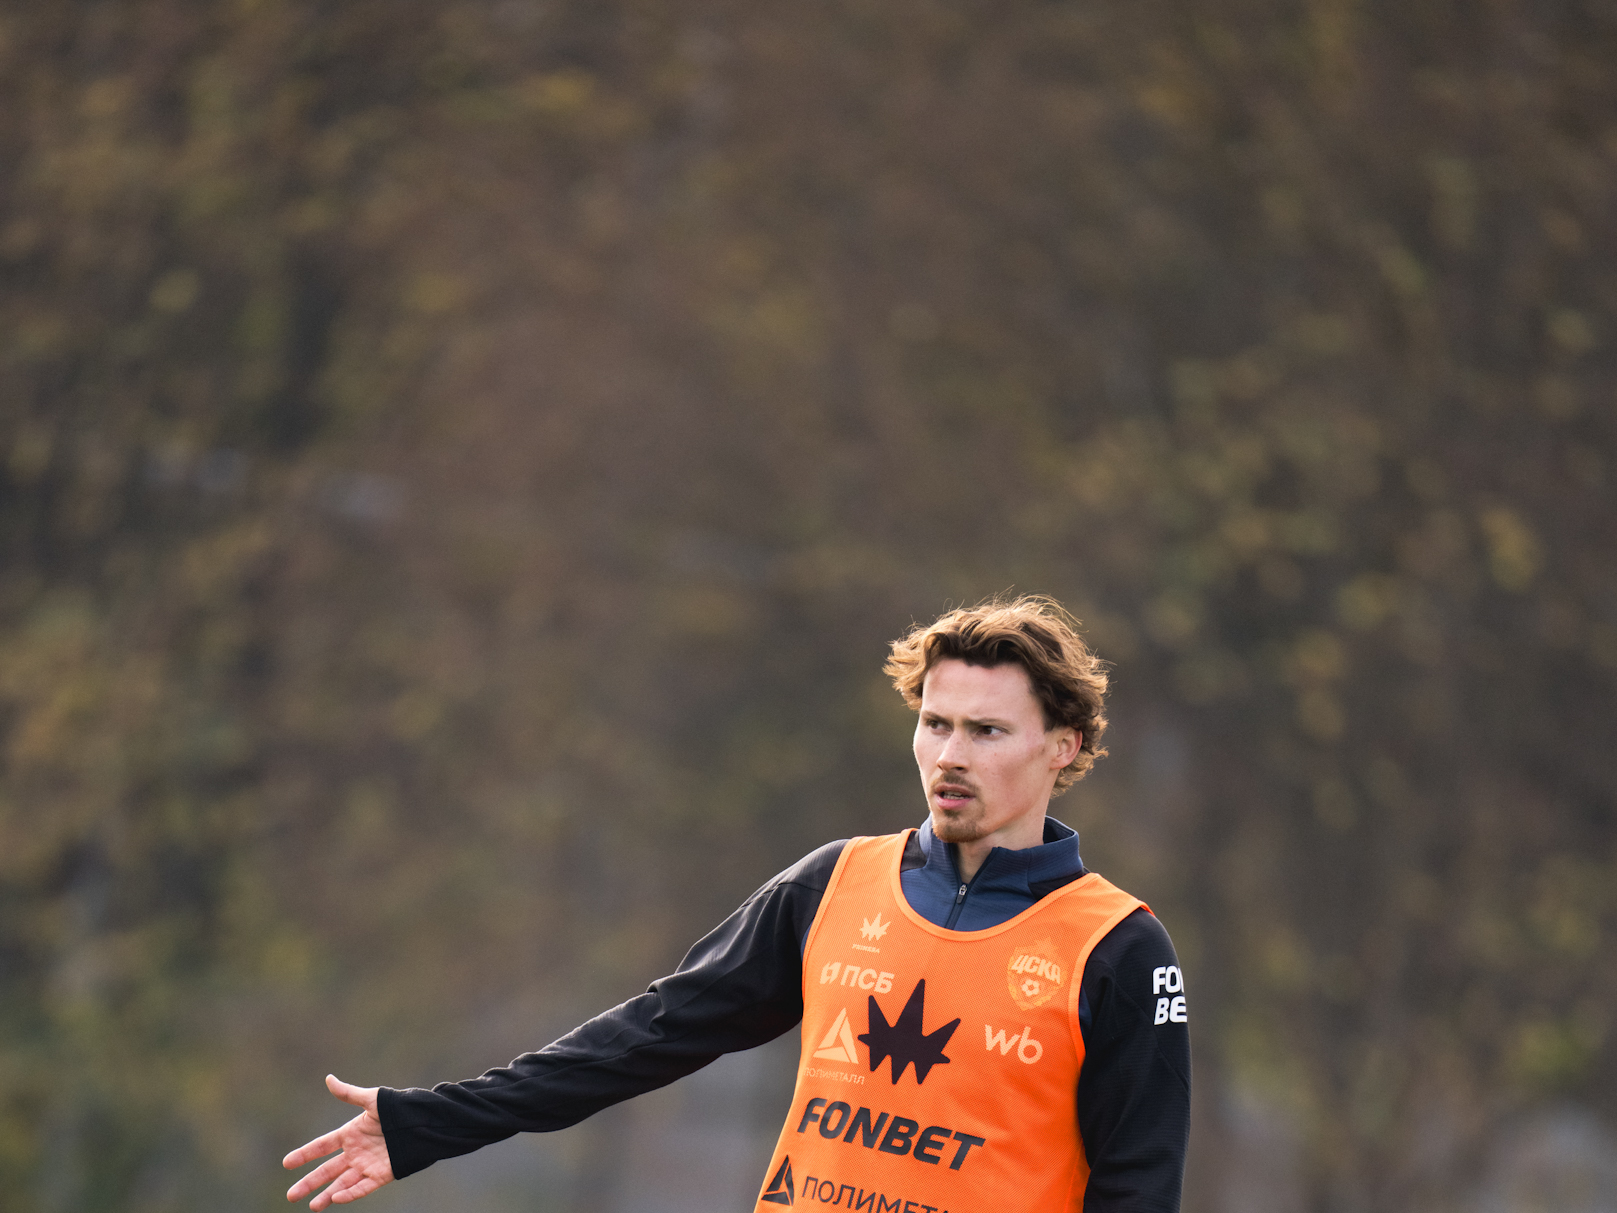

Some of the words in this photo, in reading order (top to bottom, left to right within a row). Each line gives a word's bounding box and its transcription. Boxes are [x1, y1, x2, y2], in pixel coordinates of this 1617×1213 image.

[840, 964, 895, 994] ПСБ
[1011, 954, 1061, 985] ЦСКА
[985, 1024, 1044, 1065] wb
[803, 1067, 865, 1085] ПОЛИМЕТАЛЛ
[797, 1097, 986, 1171] FONBET
